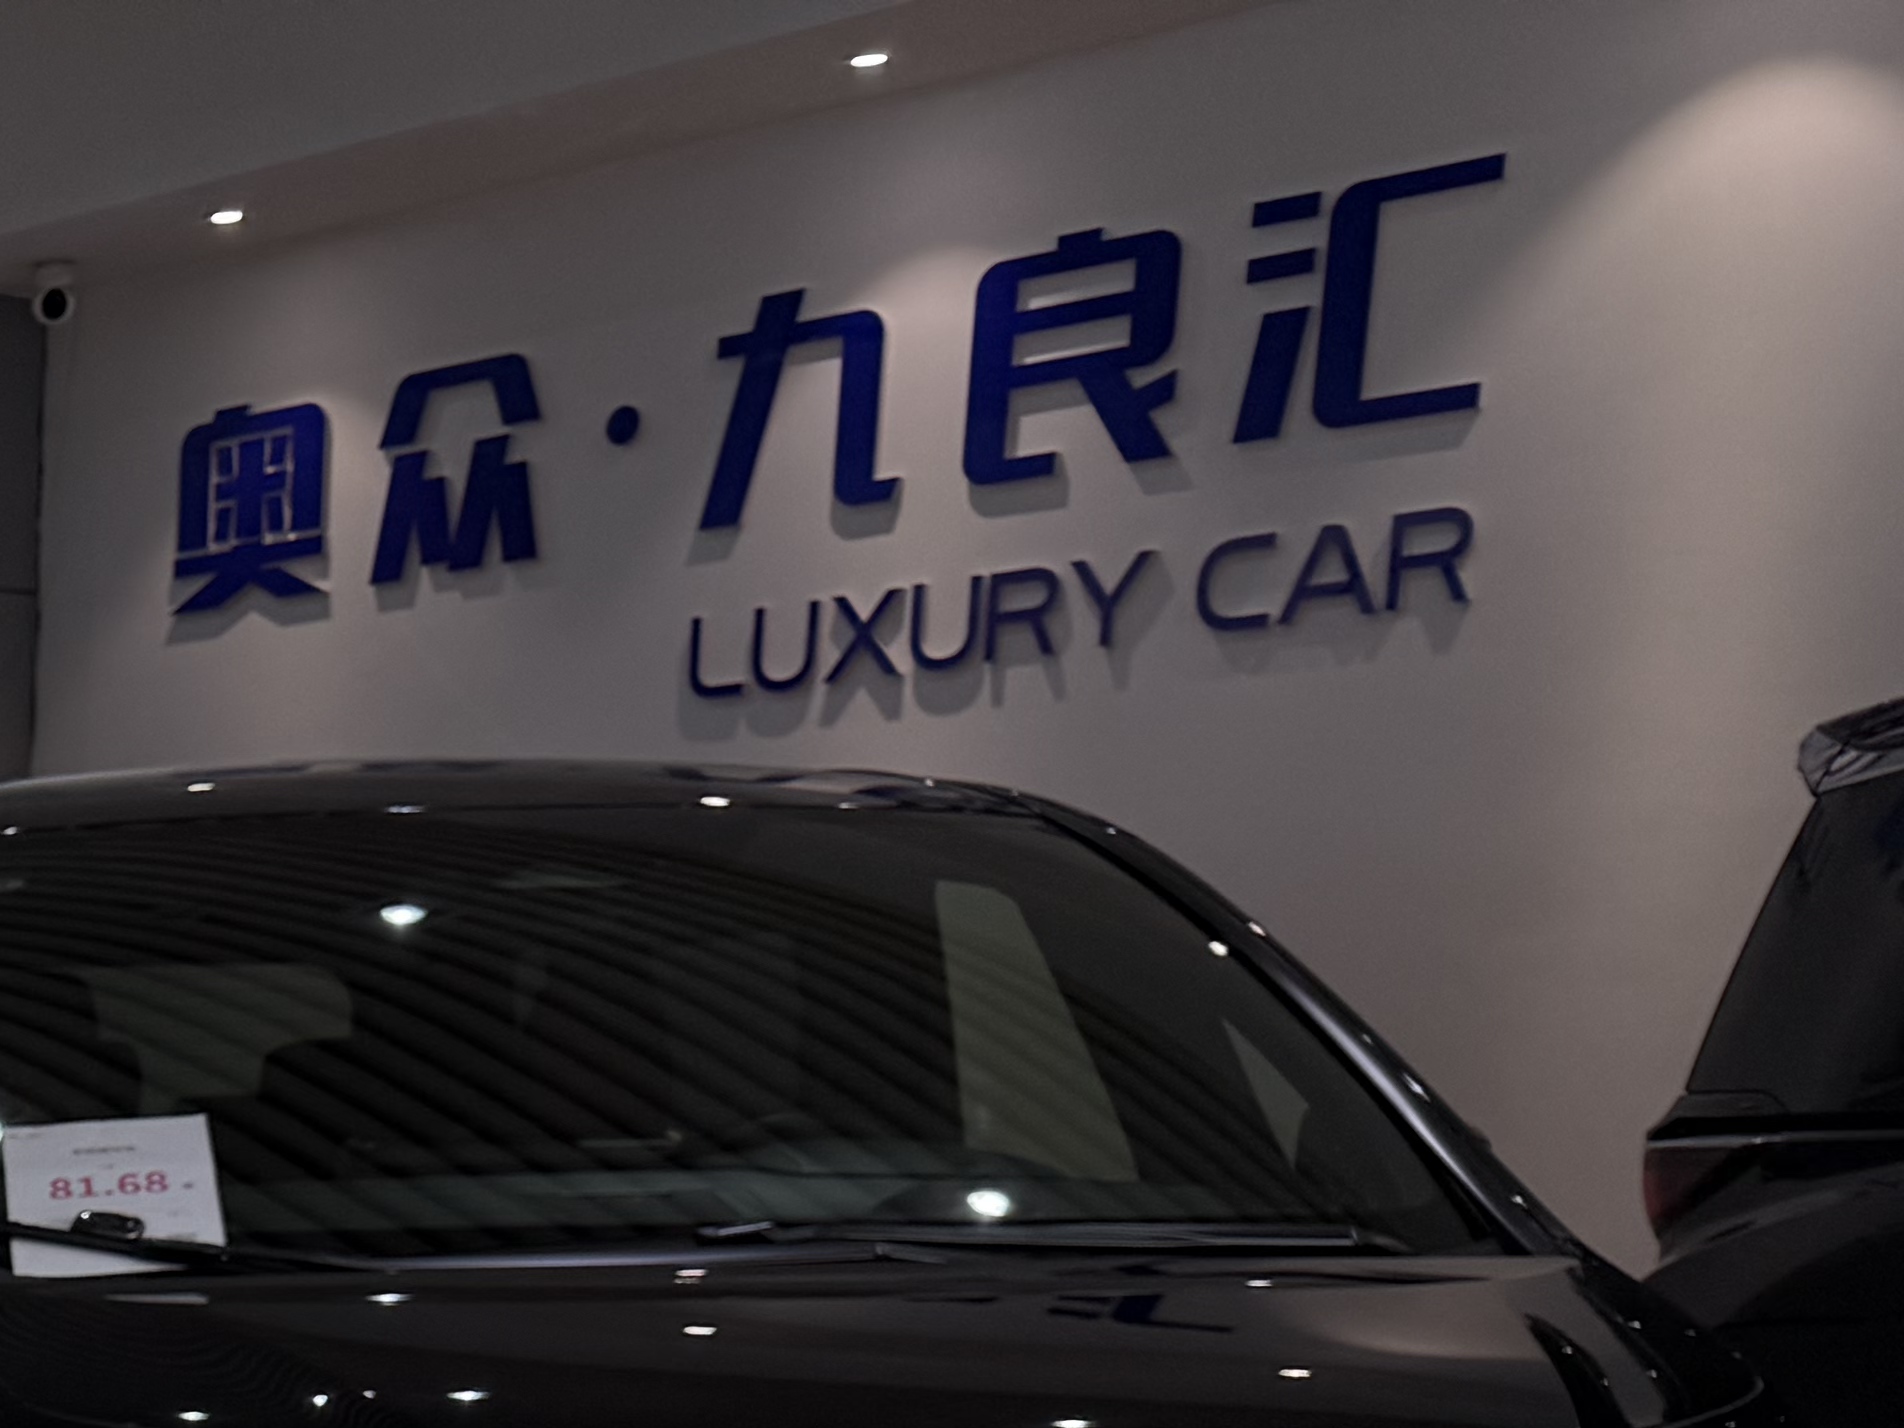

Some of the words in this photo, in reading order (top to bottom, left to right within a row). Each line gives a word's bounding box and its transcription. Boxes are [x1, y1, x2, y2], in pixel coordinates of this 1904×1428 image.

[170, 152, 1507, 617] 奥众·九良汇
[688, 548, 1160, 702] LUXURY
[1195, 504, 1476, 633] CAR
[49, 1170, 169, 1201] 81.68
